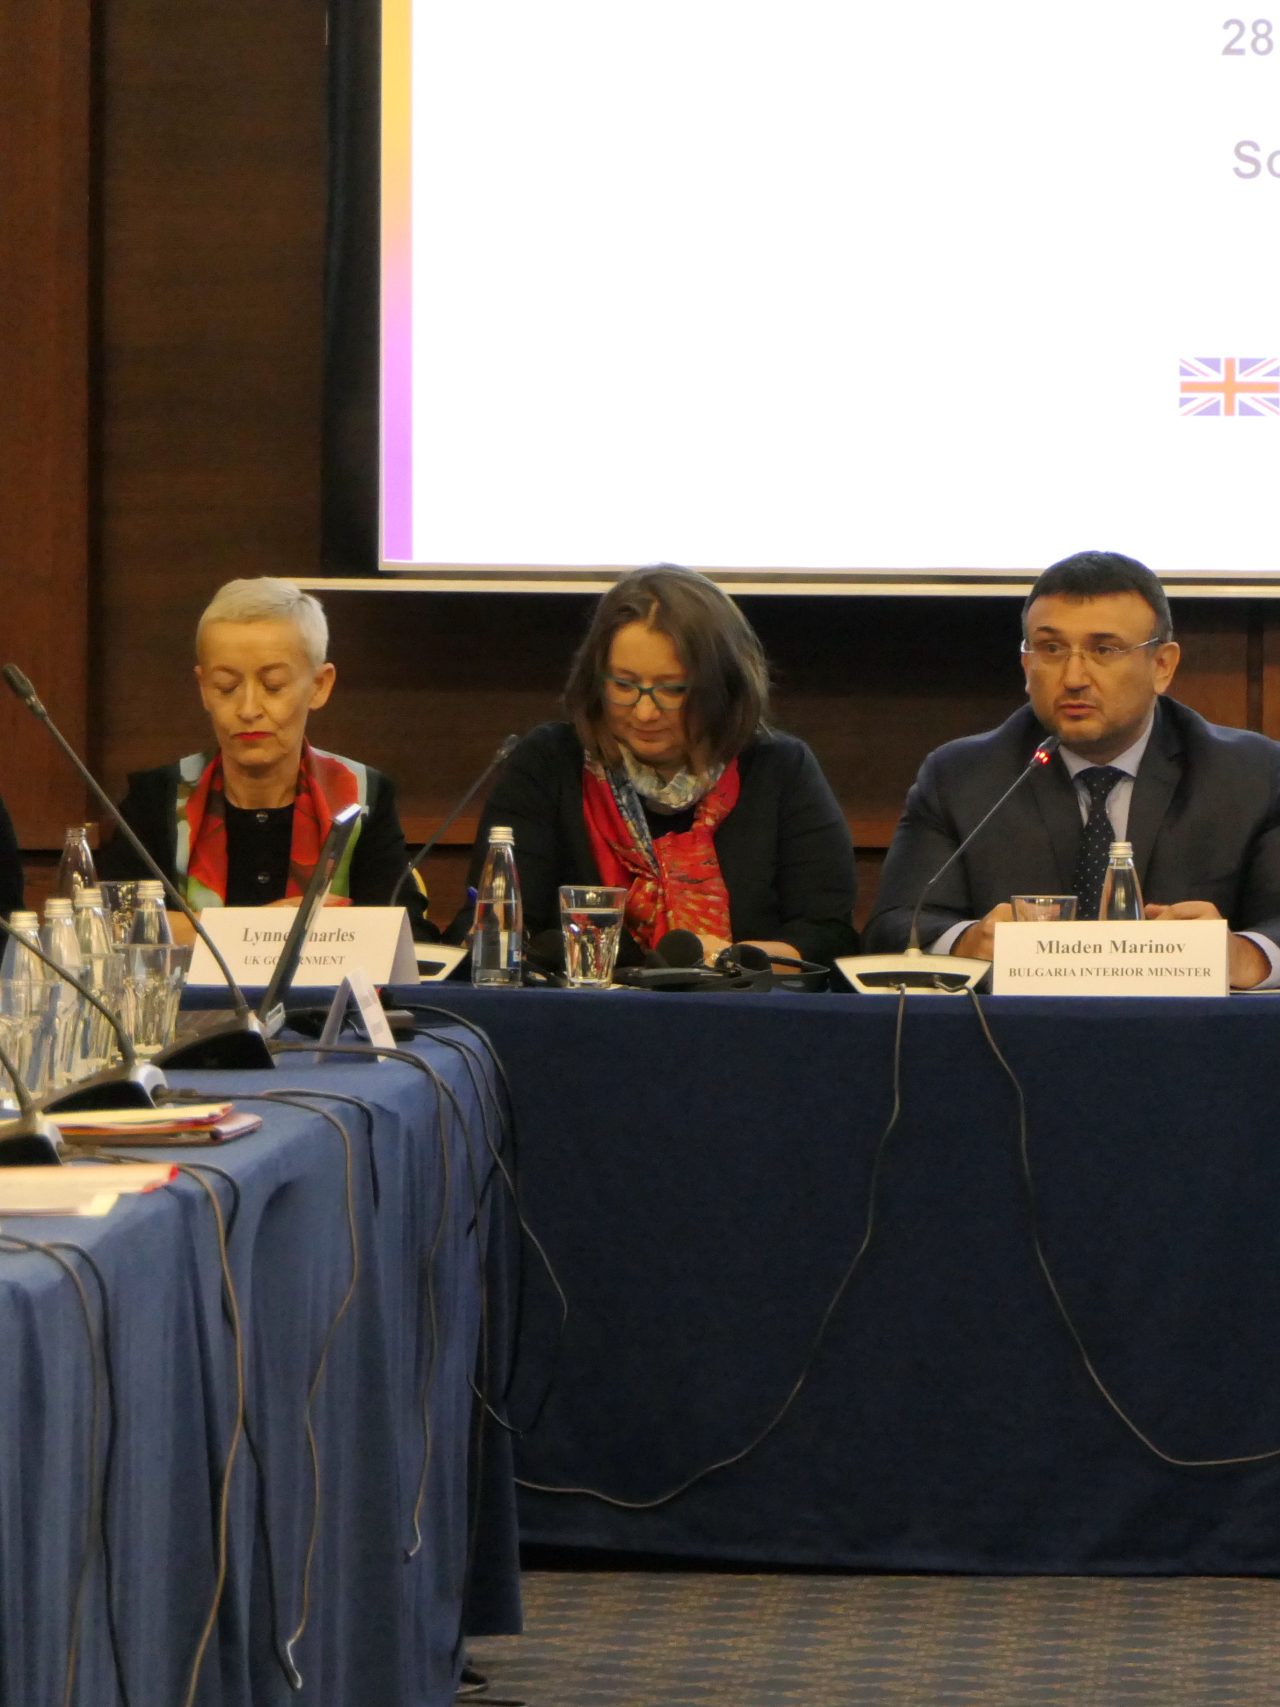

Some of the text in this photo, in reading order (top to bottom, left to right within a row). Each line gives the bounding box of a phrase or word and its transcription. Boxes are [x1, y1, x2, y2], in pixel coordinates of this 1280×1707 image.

[1221, 18, 1275, 57] 28
[300, 926, 356, 943] harles
[1036, 939, 1187, 955] Mladen Marinov
[243, 955, 261, 966] UK
[1008, 967, 1212, 978] BULGARIA INTERIOR MINISTER
